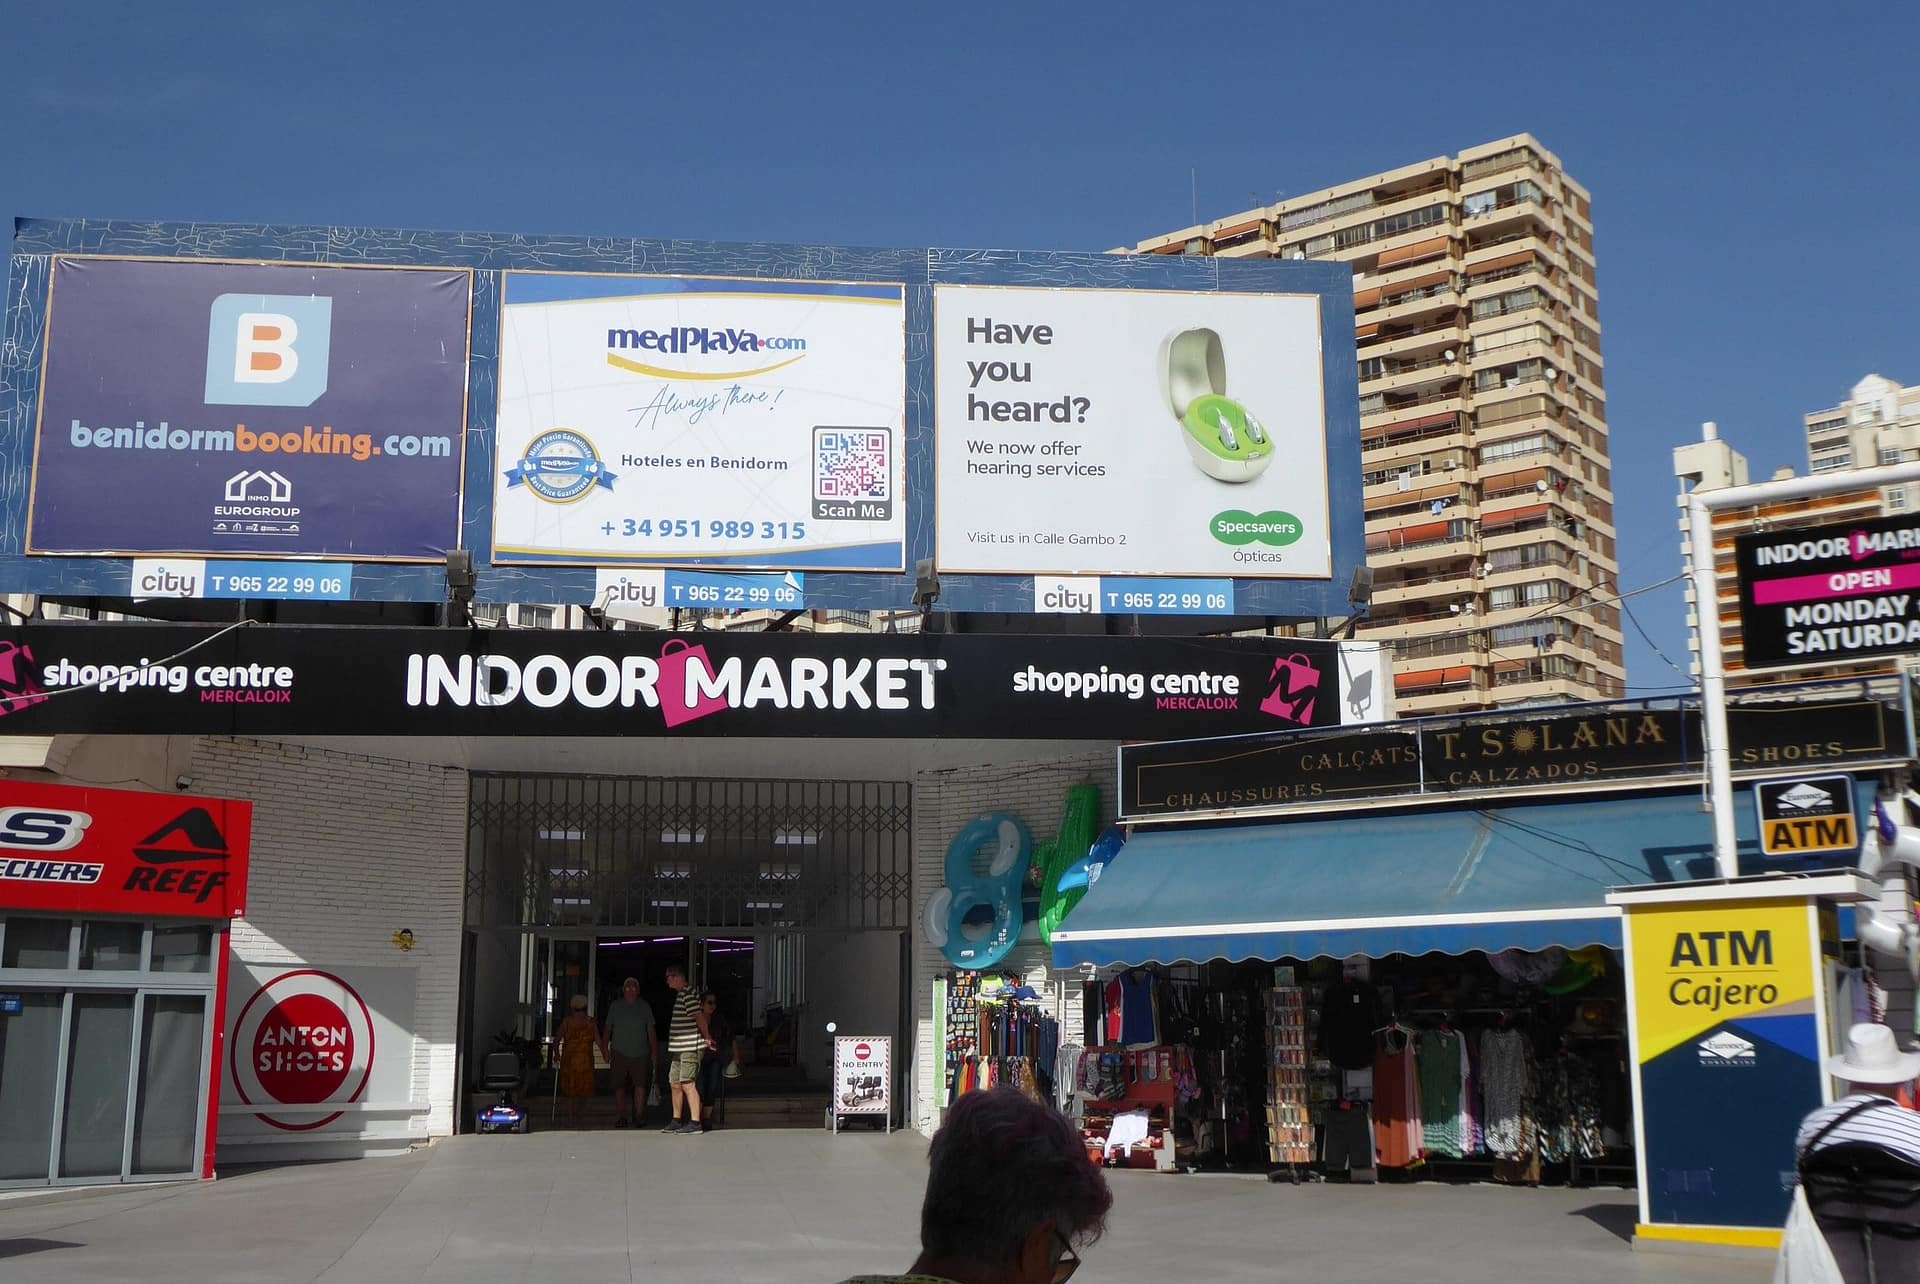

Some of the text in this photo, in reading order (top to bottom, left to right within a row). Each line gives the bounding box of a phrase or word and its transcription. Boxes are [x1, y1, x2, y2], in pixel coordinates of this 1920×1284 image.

[967, 317, 1053, 345] Have
[967, 360, 1032, 388] you
[627, 384, 720, 430] Always
[967, 394, 1091, 424] heard?
[70, 420, 450, 460] benidormbooking.com
[967, 440, 1081, 456] We now offer
[621, 454, 789, 470] Hoteles en Benidorm
[967, 460, 1106, 479] hearing services
[214, 506, 301, 517] EUROGROUP
[819, 504, 885, 518] Scan Me
[622, 519, 653, 537] 34
[659, 519, 701, 538] 951
[709, 520, 755, 539] 989
[760, 521, 806, 540] 315
[967, 531, 1128, 547] Visit us in Calle Gambo 2
[1217, 519, 1297, 537] Specsavers
[1233, 547, 1283, 564] Ópticas
[1757, 537, 1851, 566] INDOOR
[141, 567, 342, 597] city T 965 22 99 06
[605, 577, 796, 607] city T 965 22 99 06
[1829, 568, 1892, 592] OPEN
[1043, 585, 1226, 612] city T 965 22 99 06
[1786, 595, 1910, 628] MONDAY
[43, 657, 294, 693] shopping centre
[405, 652, 948, 710] INDOOR MARKET
[1012, 664, 1240, 699] shopping centre
[201, 689, 291, 704] MERCALOIX
[1156, 696, 1238, 711] MERCALOIX
[1301, 745, 1418, 772] CALÇATS
[1437, 732, 1467, 761] T.
[1743, 741, 1844, 764] SHOES
[1449, 761, 1599, 785] CALZADOS
[1166, 782, 1324, 807] CHAUSSURES
[1771, 818, 1850, 850] ATM
[122, 867, 230, 903] REEF
[1670, 929, 1774, 968] ATM
[1669, 977, 1778, 1012] Cajero
[260, 1026, 347, 1047] ANTON
[259, 1050, 344, 1072] SHOES
